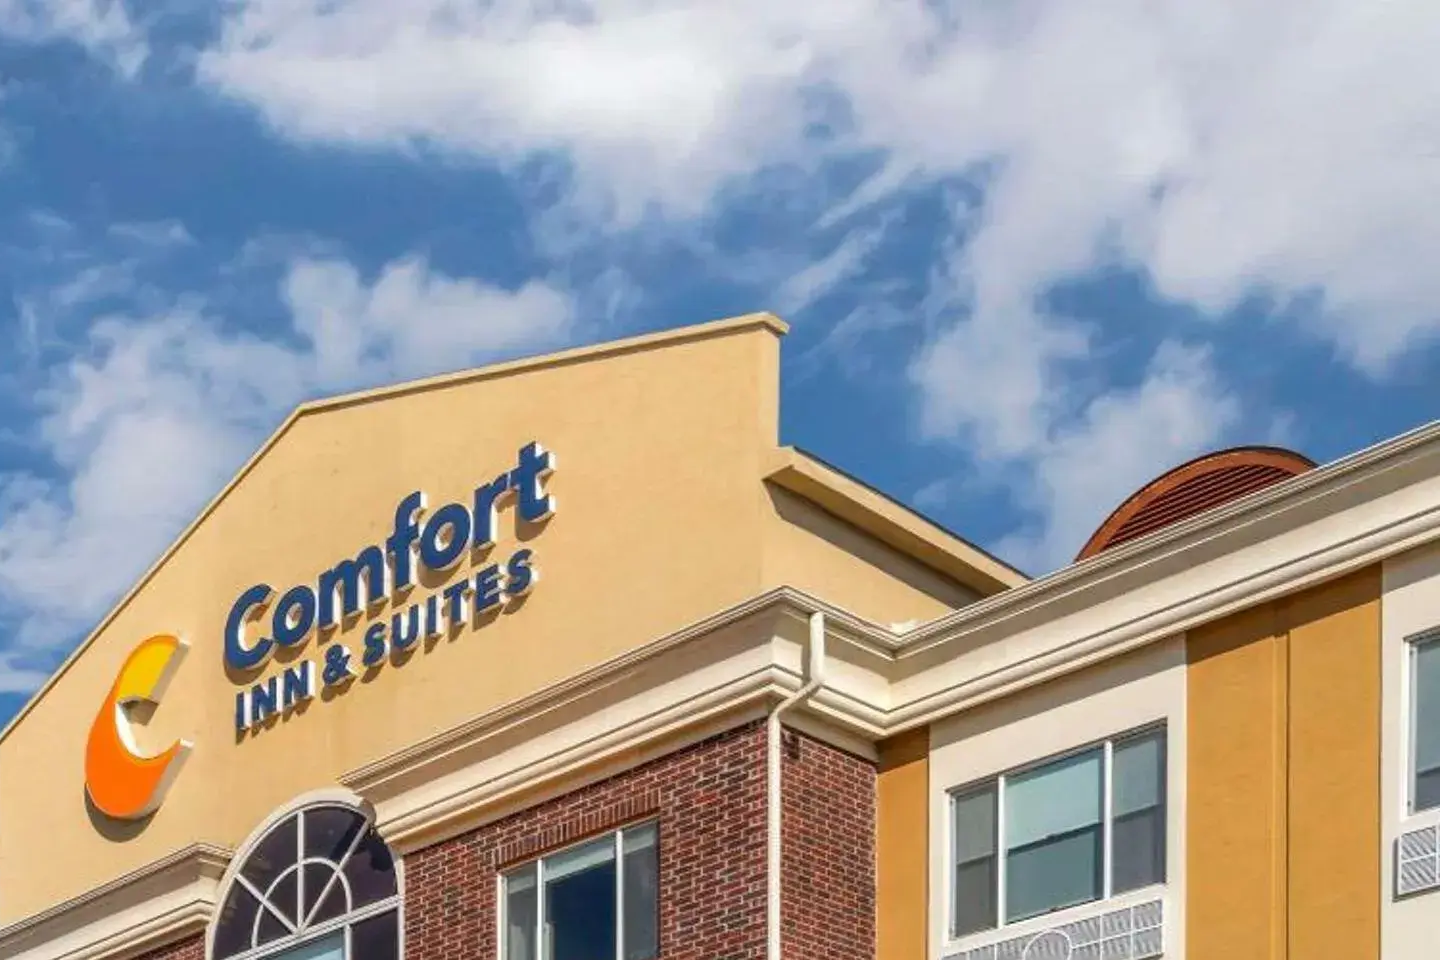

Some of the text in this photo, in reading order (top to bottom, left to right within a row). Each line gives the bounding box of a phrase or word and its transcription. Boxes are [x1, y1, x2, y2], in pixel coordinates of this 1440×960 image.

[224, 441, 554, 670] Comfort
[236, 549, 539, 729] INN & SUITES
